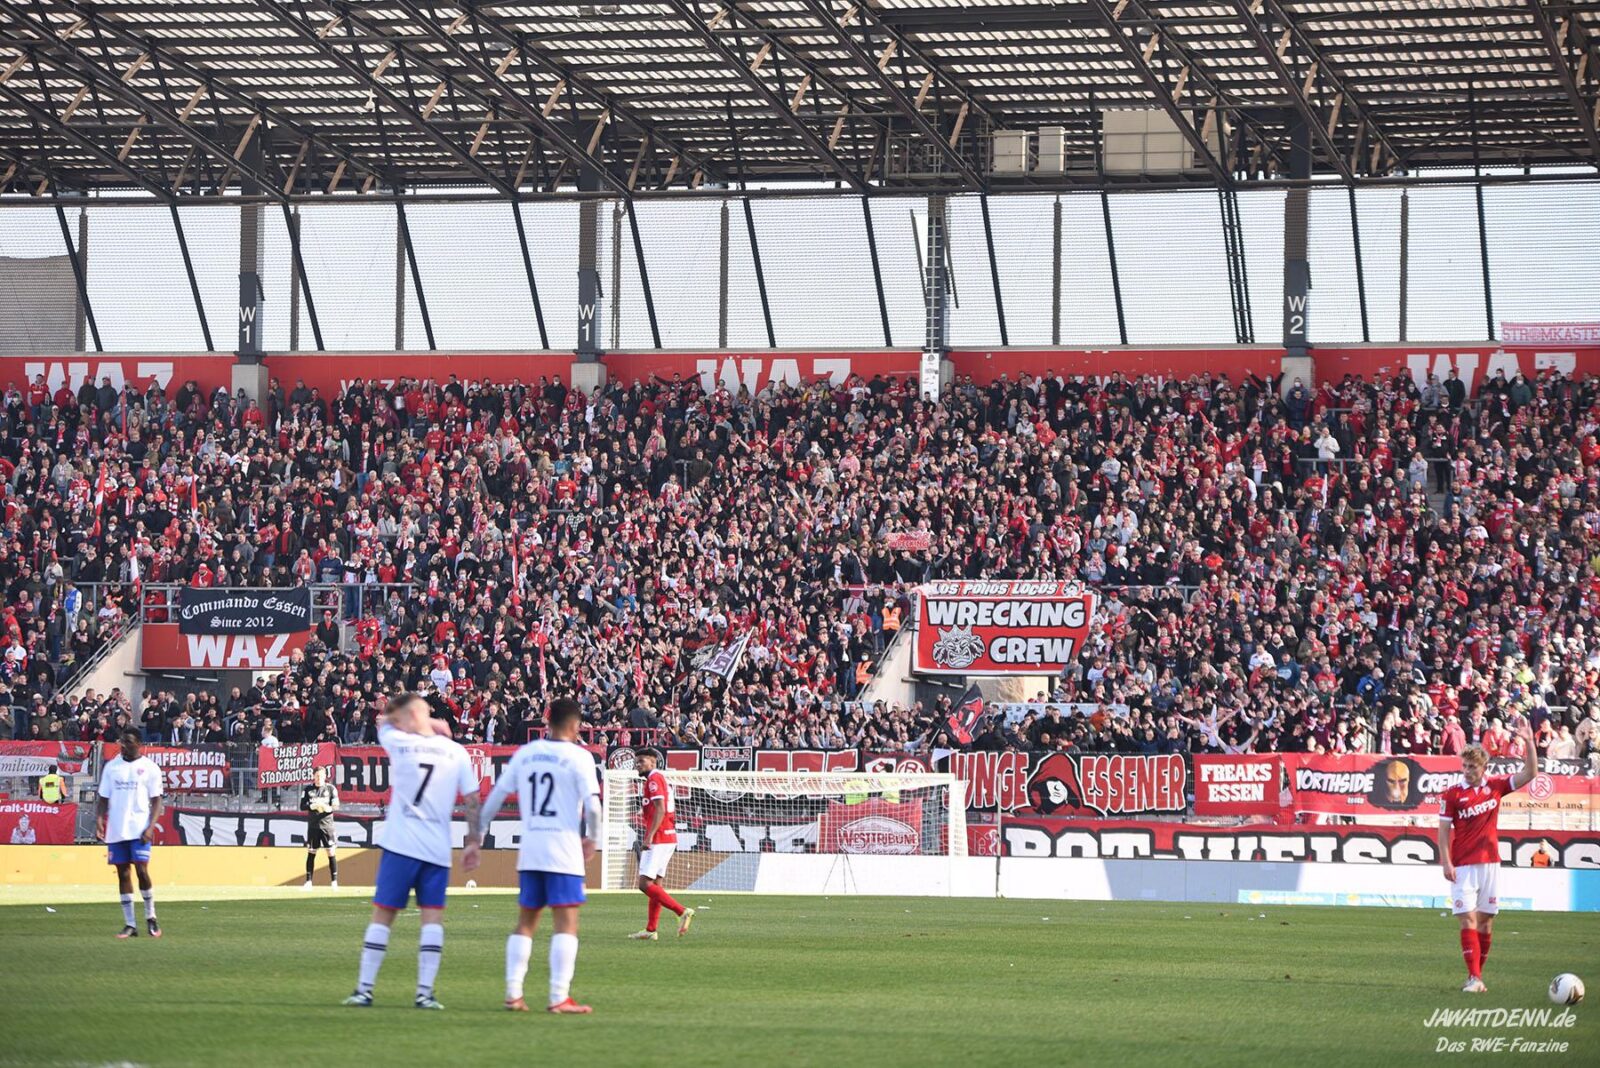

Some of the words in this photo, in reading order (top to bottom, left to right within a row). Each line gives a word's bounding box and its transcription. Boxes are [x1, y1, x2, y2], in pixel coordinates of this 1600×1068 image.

[239, 306, 256, 322] W
[578, 304, 595, 320] W
[1288, 296, 1306, 312] W
[242, 325, 250, 344] 1
[582, 323, 590, 342] 1
[1290, 315, 1304, 335] 2
[181, 596, 259, 620] Commando
[263, 596, 307, 618] Essen
[927, 600, 1085, 628] WRECKING
[210, 616, 242, 628] Since
[245, 616, 274, 628] 2012
[184, 634, 291, 668] WAZ
[990, 637, 1074, 663] CREW
[300, 743, 318, 756] DER
[260, 765, 333, 784] STADIONVERT
[1200, 763, 1273, 783] FREAKS
[412, 764, 435, 806] 7
[1080, 753, 1187, 814] ESSENER
[1208, 783, 1265, 803] ESSEN
[527, 771, 558, 818] 12
